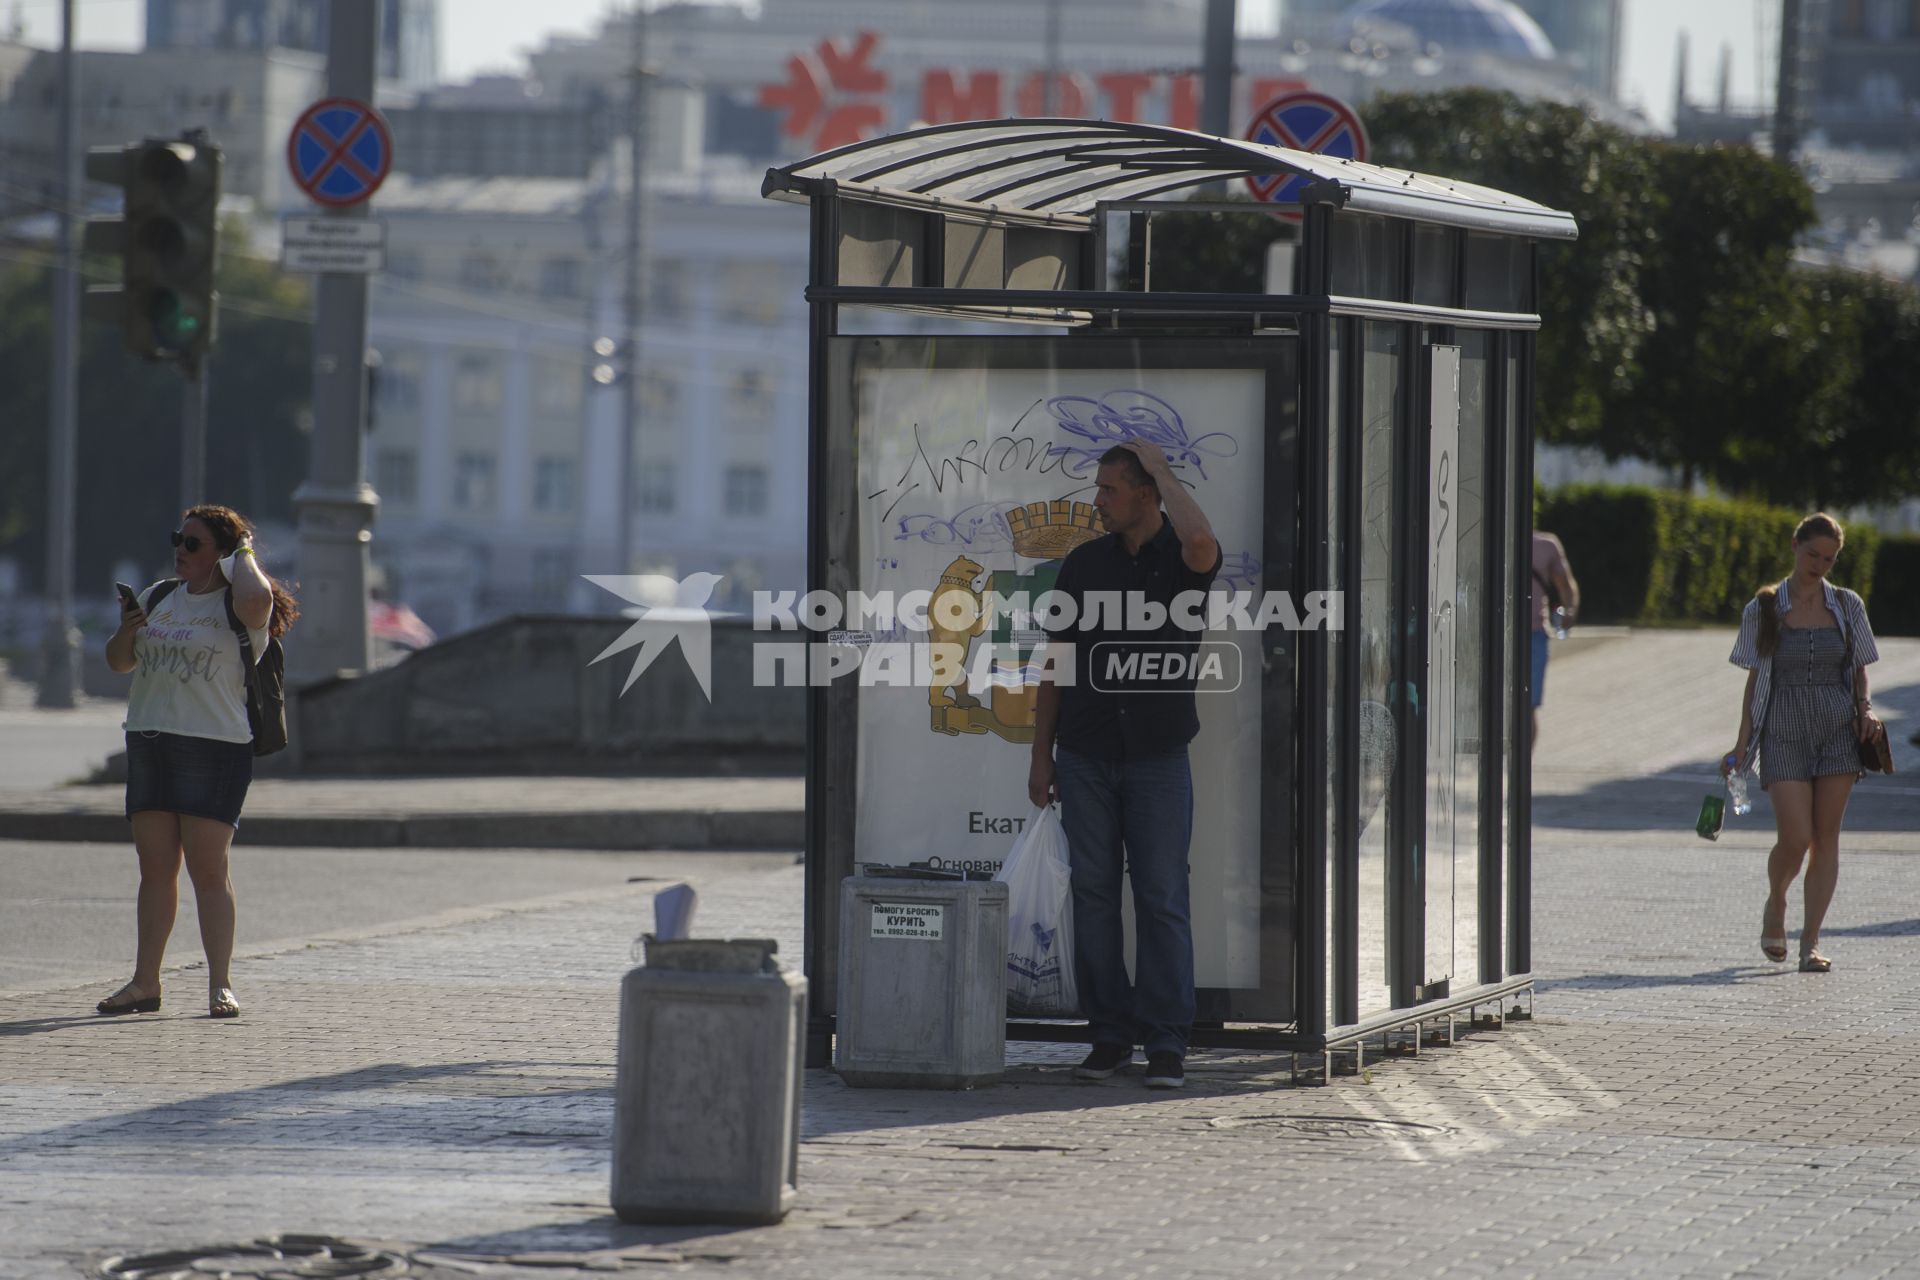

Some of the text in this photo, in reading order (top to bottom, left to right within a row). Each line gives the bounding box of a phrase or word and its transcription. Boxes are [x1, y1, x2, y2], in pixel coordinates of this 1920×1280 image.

[874, 906, 940, 916] ПОМОГУ БРОСИТЬ
[887, 916, 926, 927] КУРИТЬ
